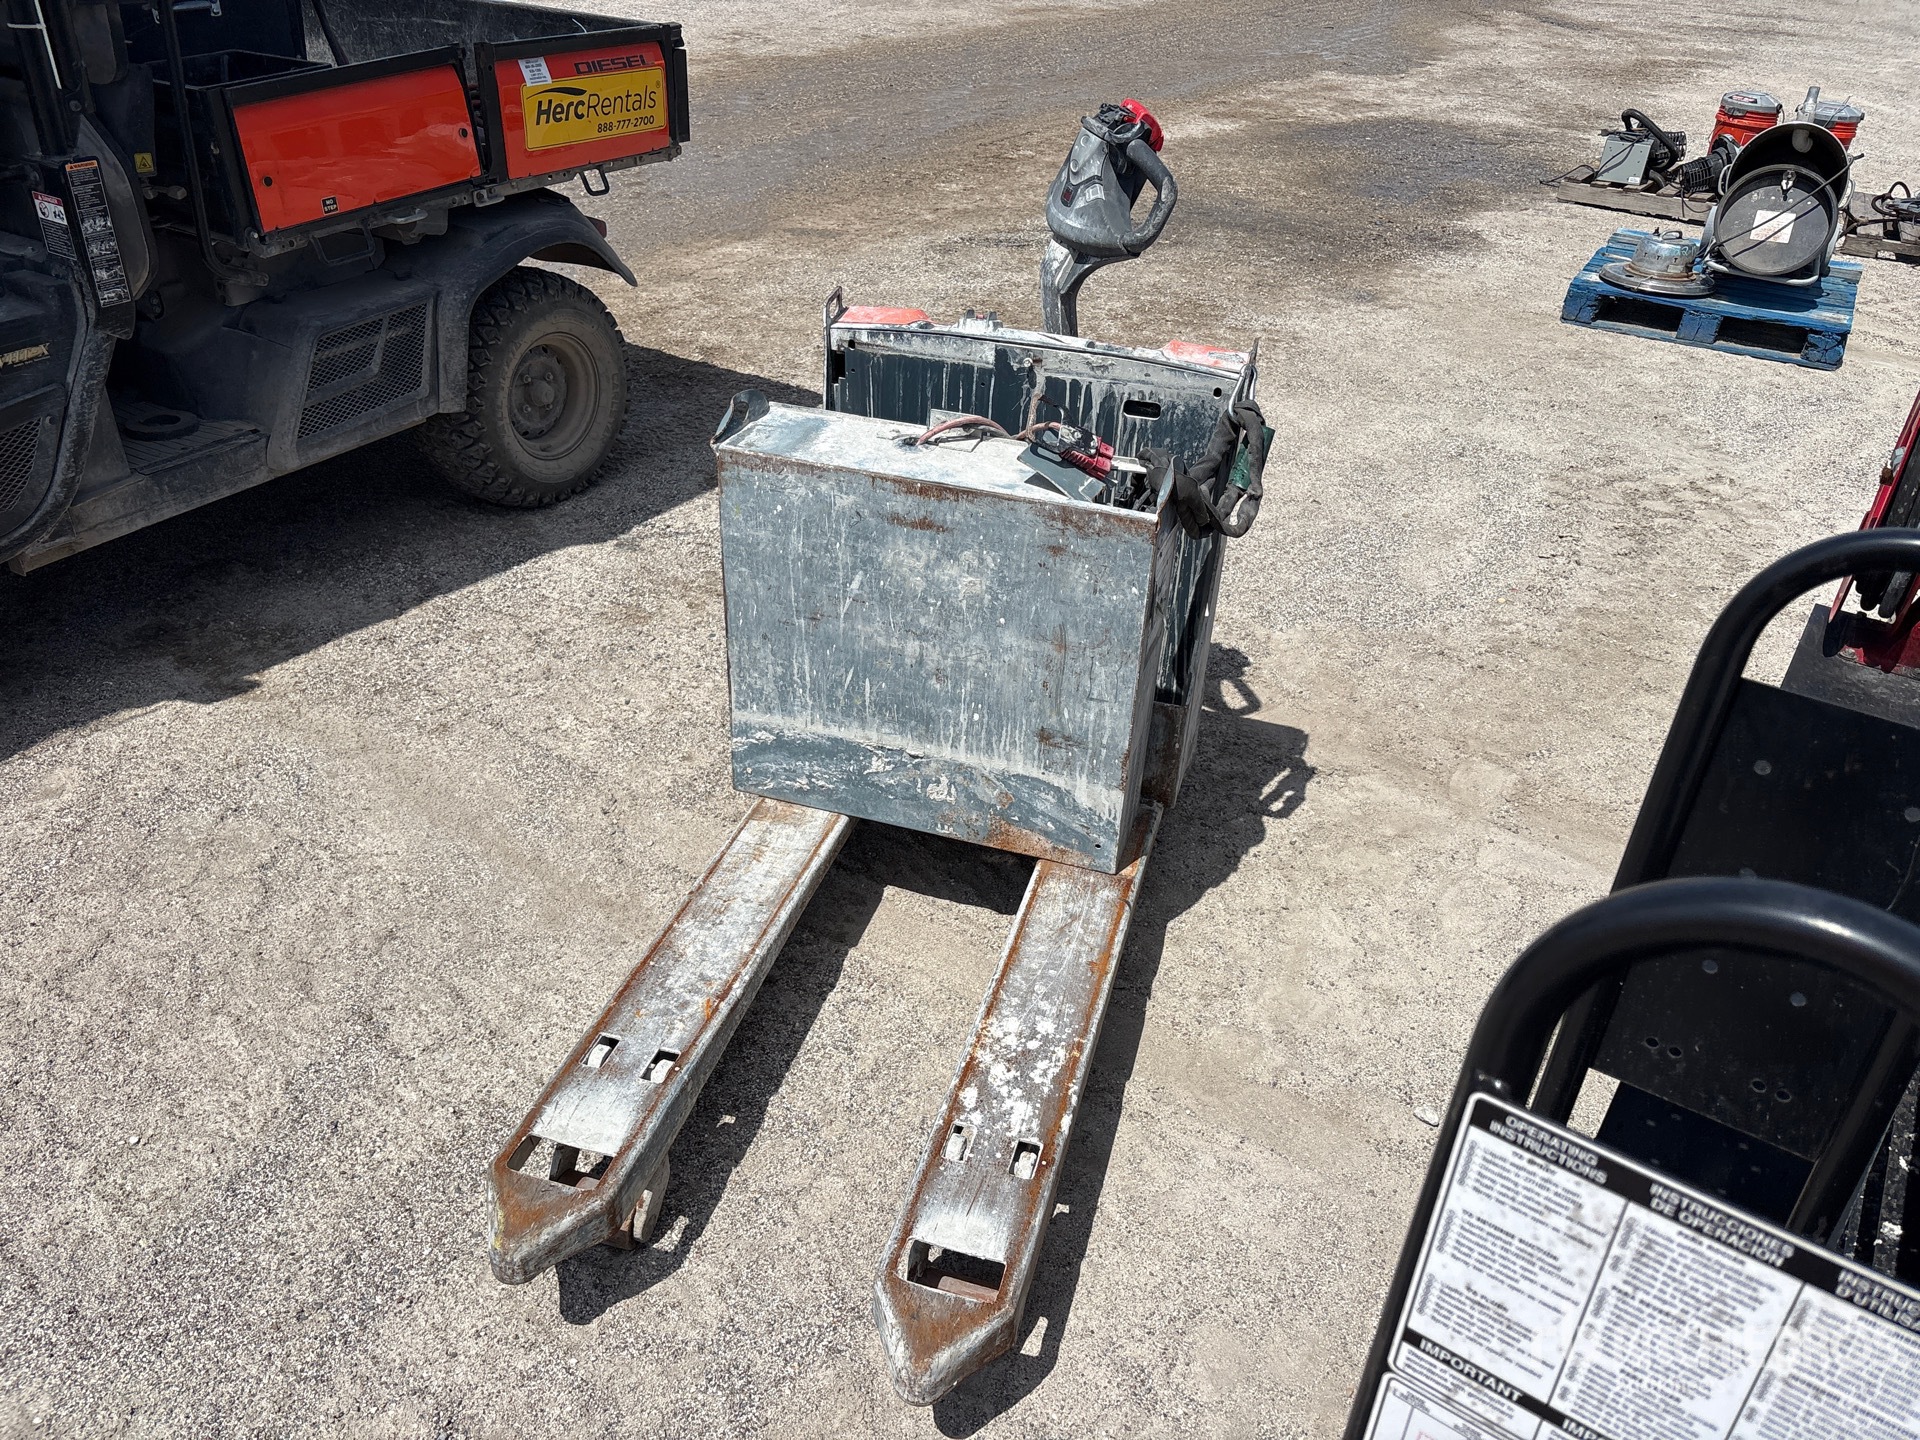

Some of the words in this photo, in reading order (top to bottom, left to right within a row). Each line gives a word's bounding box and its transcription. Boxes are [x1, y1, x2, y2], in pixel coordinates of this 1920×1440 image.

[574, 54, 654, 75] DIESEL
[597, 115, 655, 134] 888-777-2700
[325, 198, 334, 206] NO
[1489, 1120, 1609, 1185] INSTRUCTIONS
[1505, 1115, 1599, 1166] OPERATING
[1649, 1183, 1796, 1259] INSTRUCCIONES
[1649, 1197, 1676, 1217] DE
[1679, 1205, 1786, 1267] OPERACION
[1419, 1338, 1524, 1403] IMPORTANT
[1562, 1418, 1605, 1440] IMP
